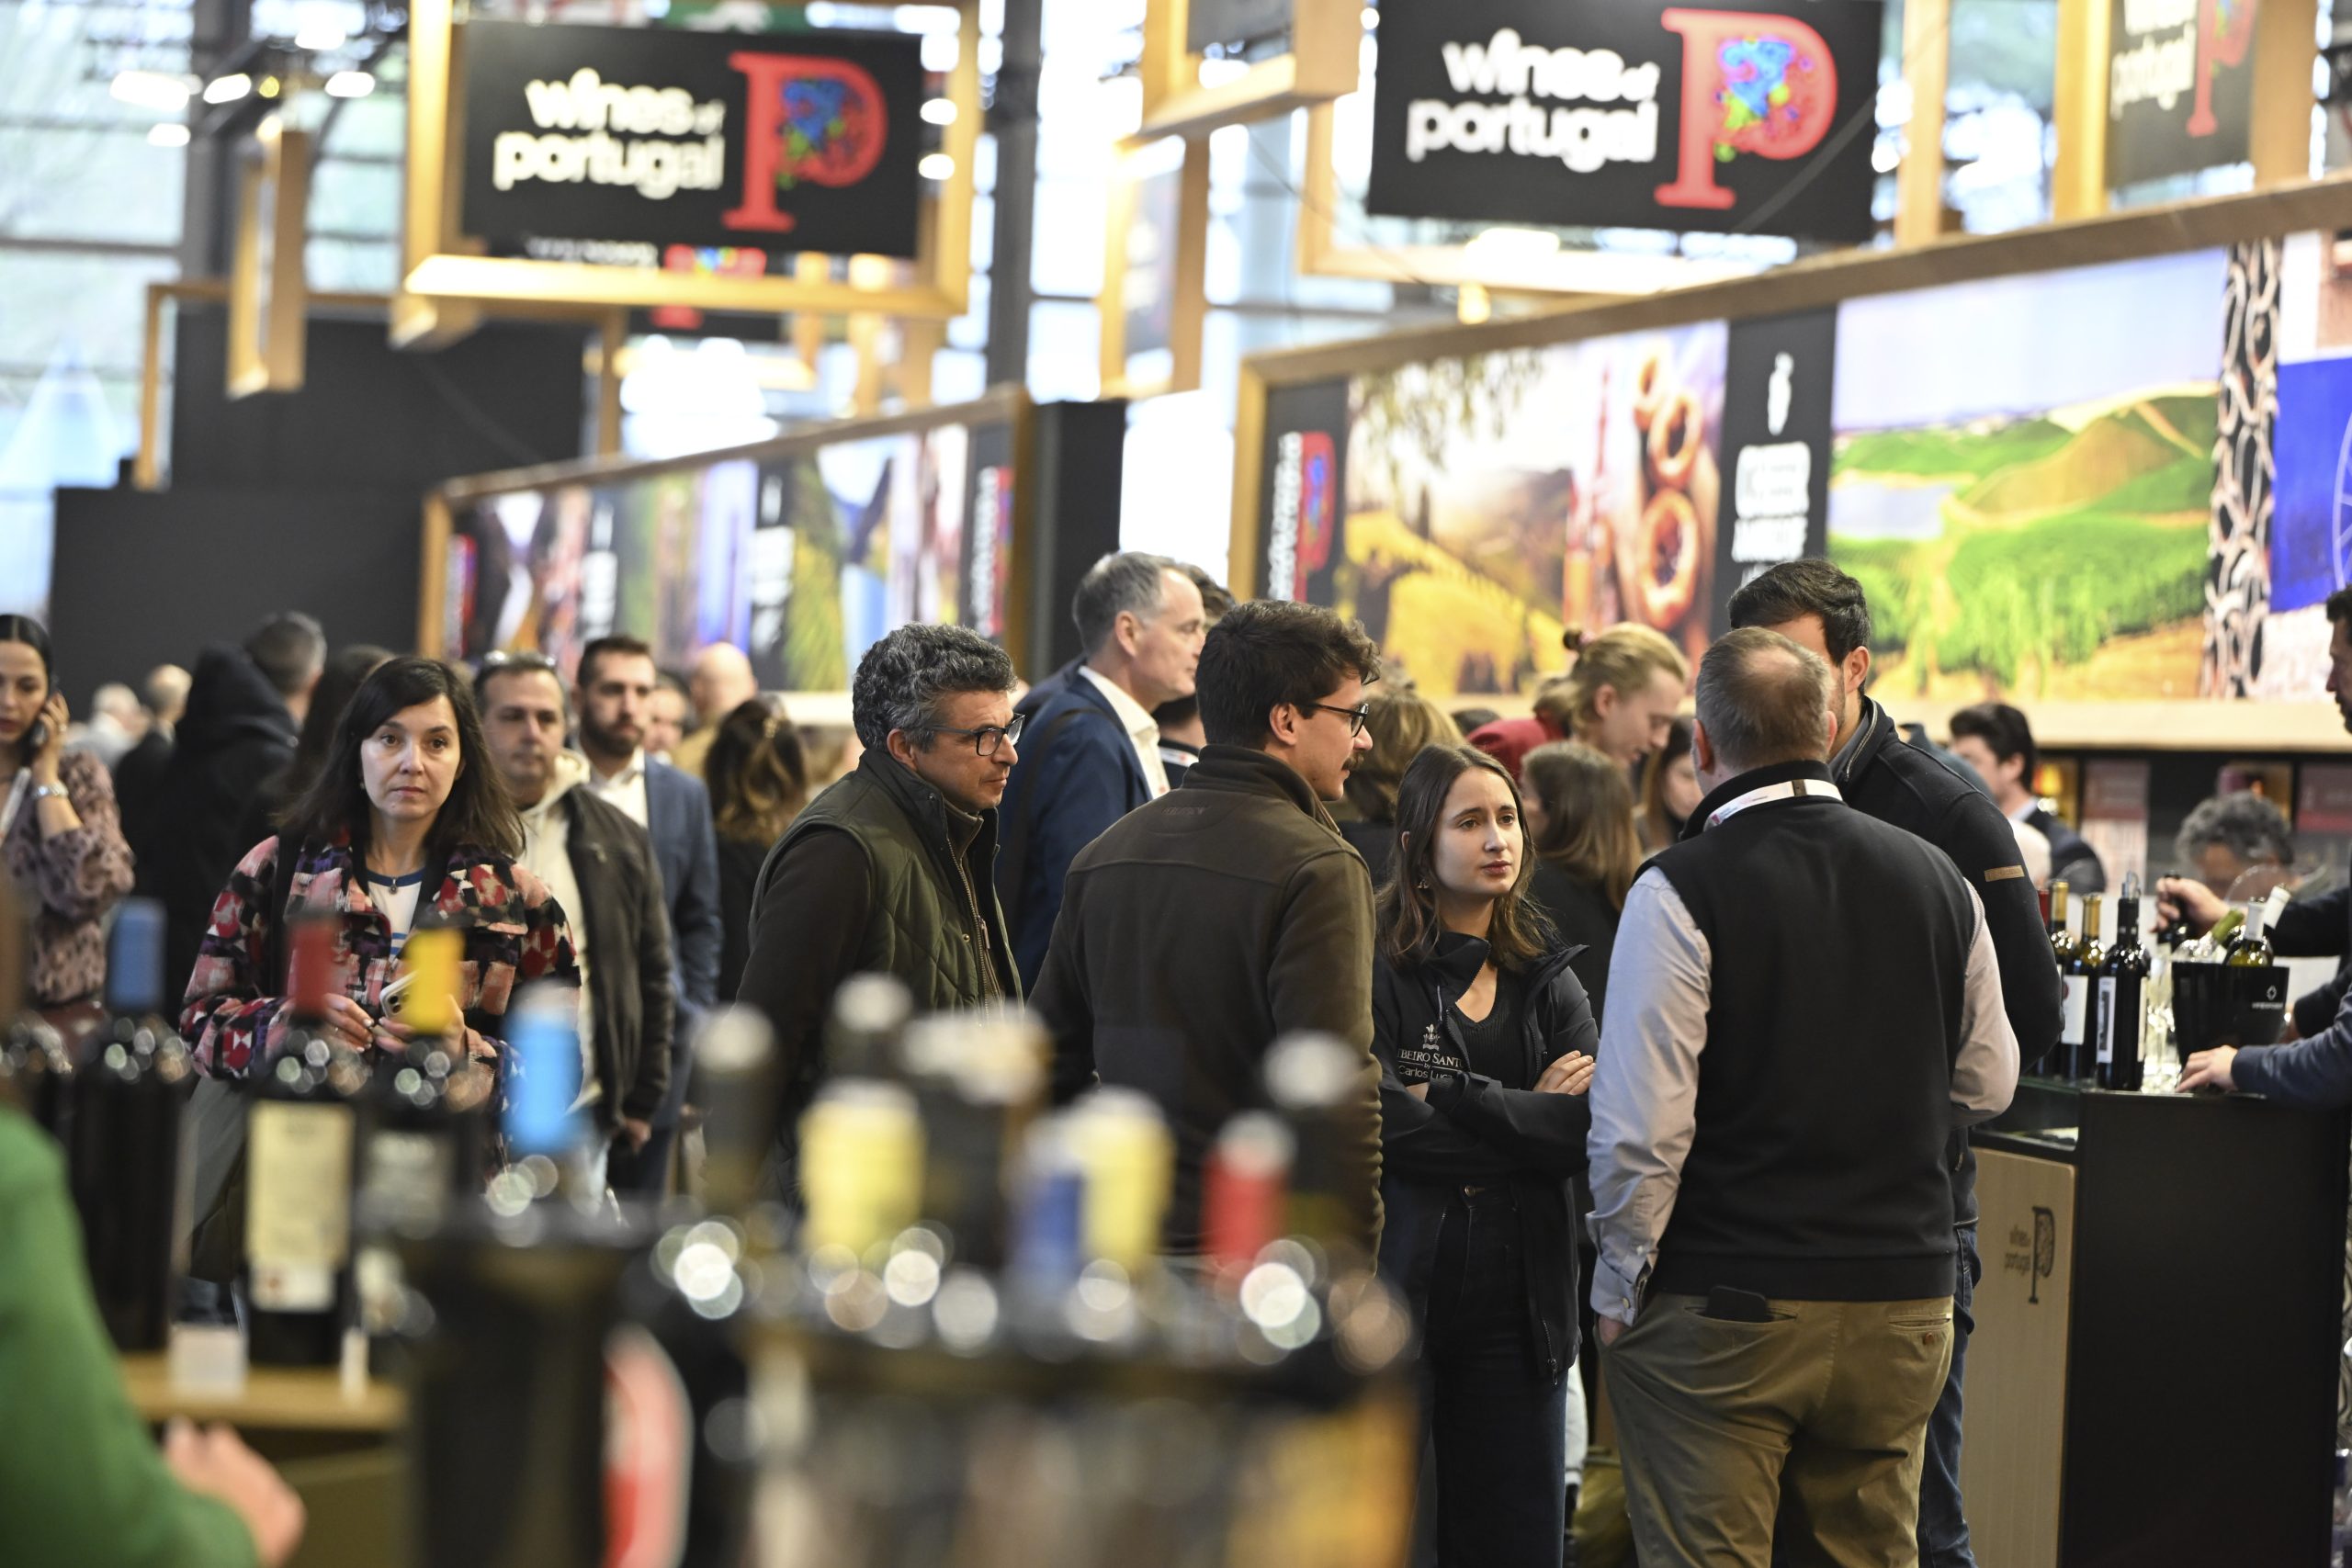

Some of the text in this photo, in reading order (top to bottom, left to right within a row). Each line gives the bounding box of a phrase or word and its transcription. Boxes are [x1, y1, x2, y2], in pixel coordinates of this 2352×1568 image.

[1442, 28, 1623, 101] wines
[526, 67, 695, 135] wines
[1406, 96, 1658, 173] portugal
[493, 130, 725, 199] portugal
[1398, 1065, 1428, 1078] Carlos
[1432, 1053, 1462, 1067] SANT
